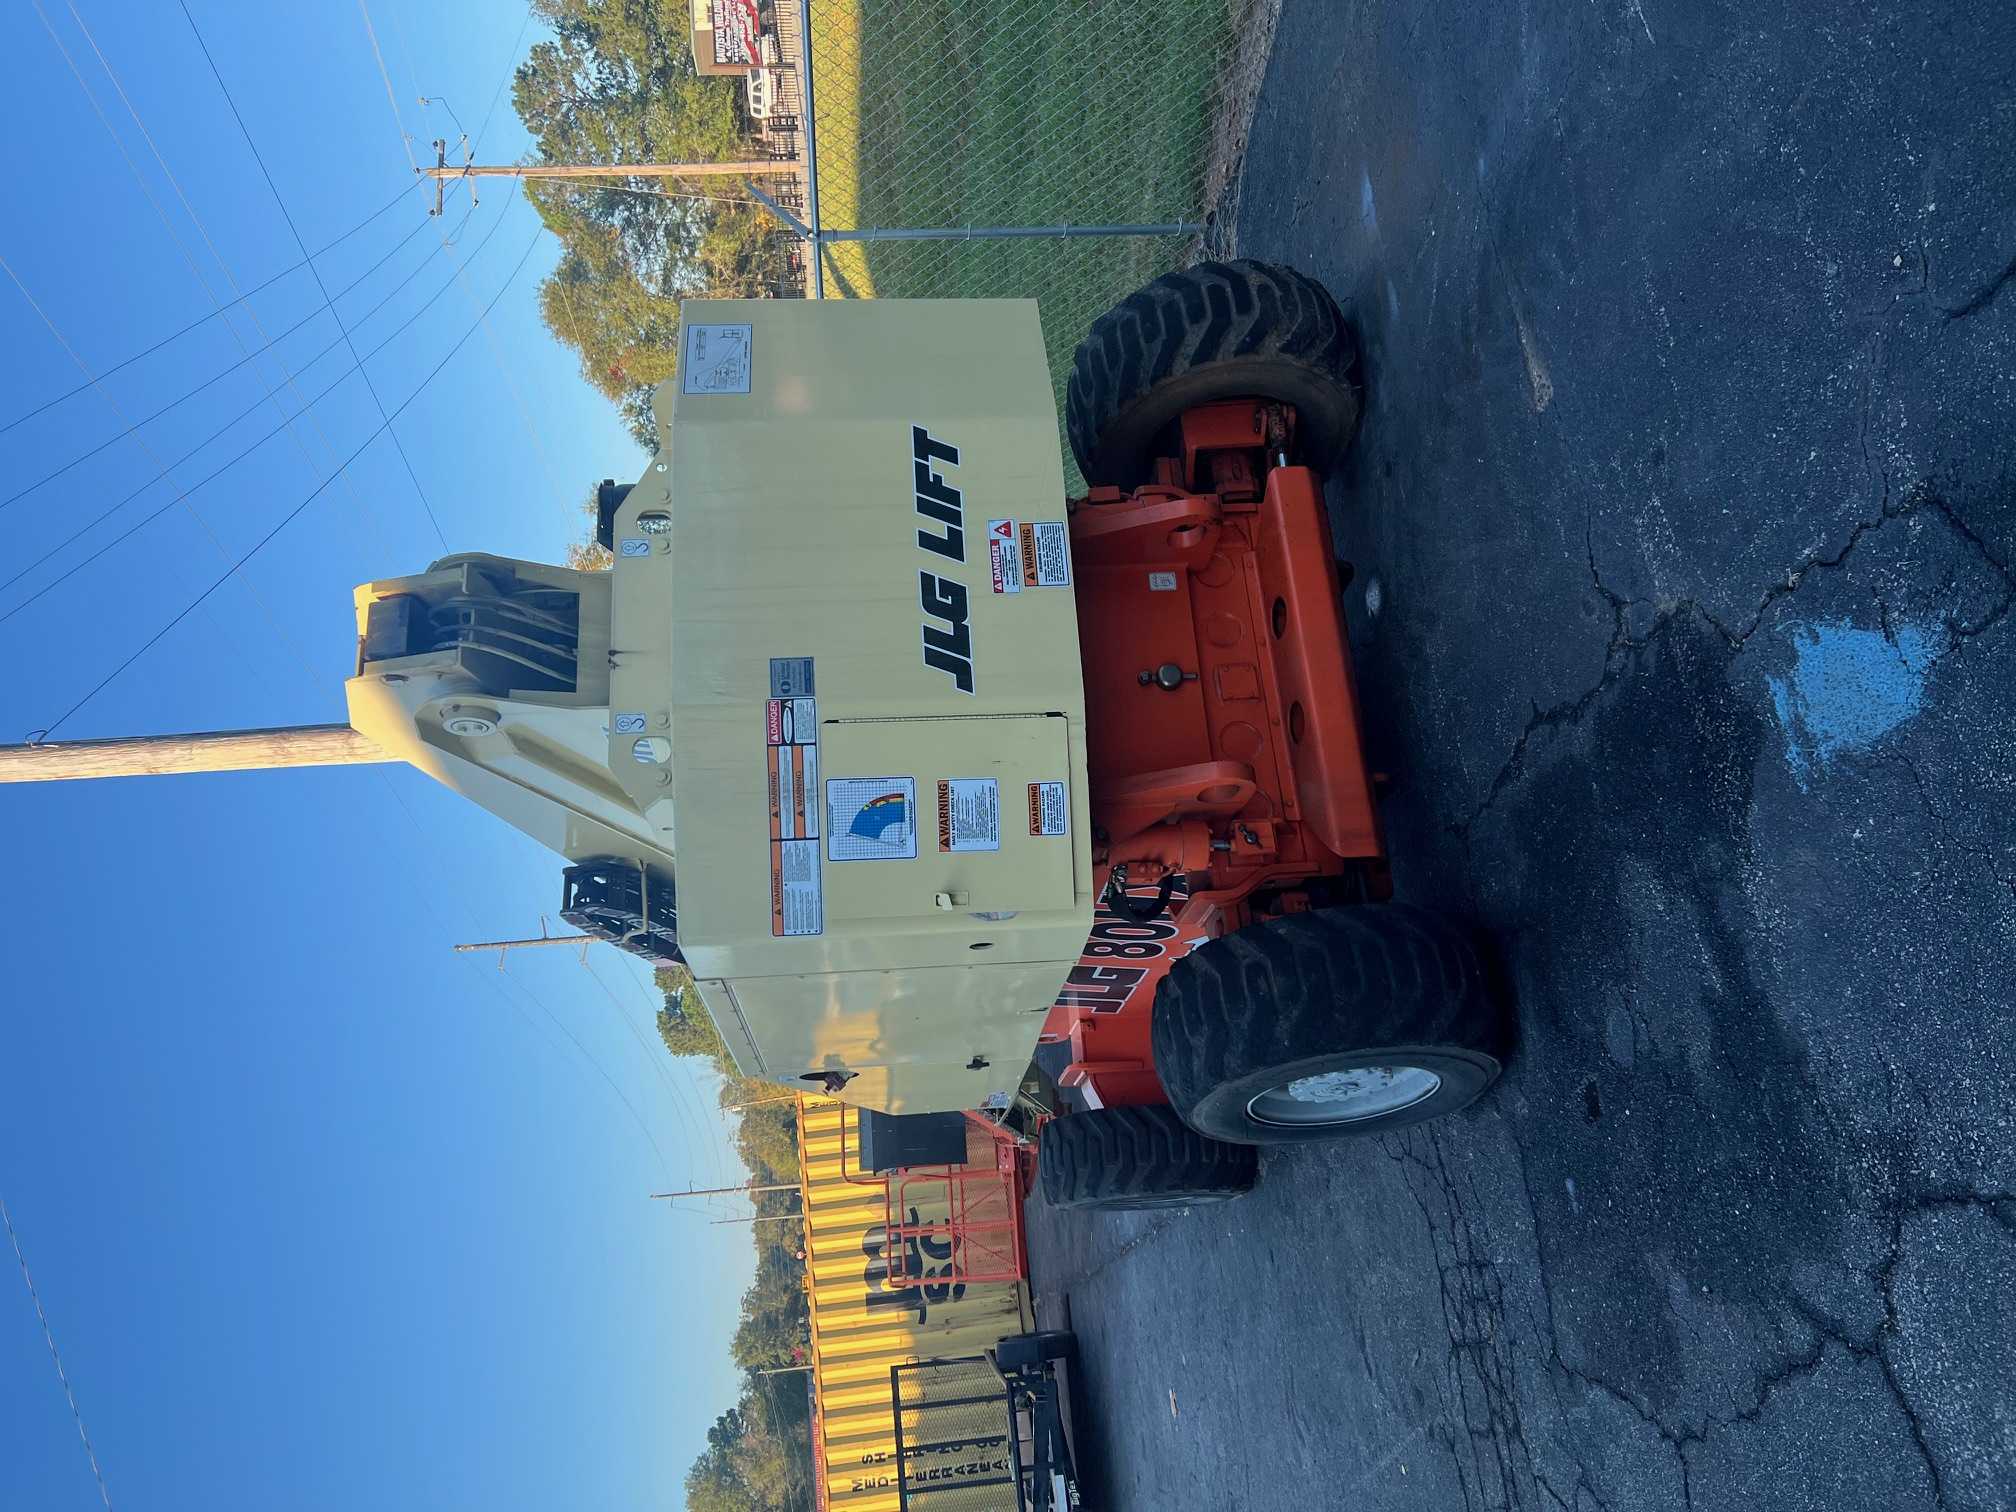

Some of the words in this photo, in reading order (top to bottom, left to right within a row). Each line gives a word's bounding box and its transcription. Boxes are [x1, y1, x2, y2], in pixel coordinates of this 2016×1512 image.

[715, 29, 726, 62] BAUTISTA
[911, 424, 967, 564] LIFT
[992, 545, 1001, 581] DANGER
[1023, 529, 1034, 570] WARNING
[918, 568, 975, 696] JLG
[770, 702, 778, 734] DANGER
[939, 783, 949, 836] WARNING
[1030, 785, 1039, 825] WARNING
[1053, 965, 1149, 1014] JLG
[852, 1459, 1010, 1492] MEDIERRANEA
